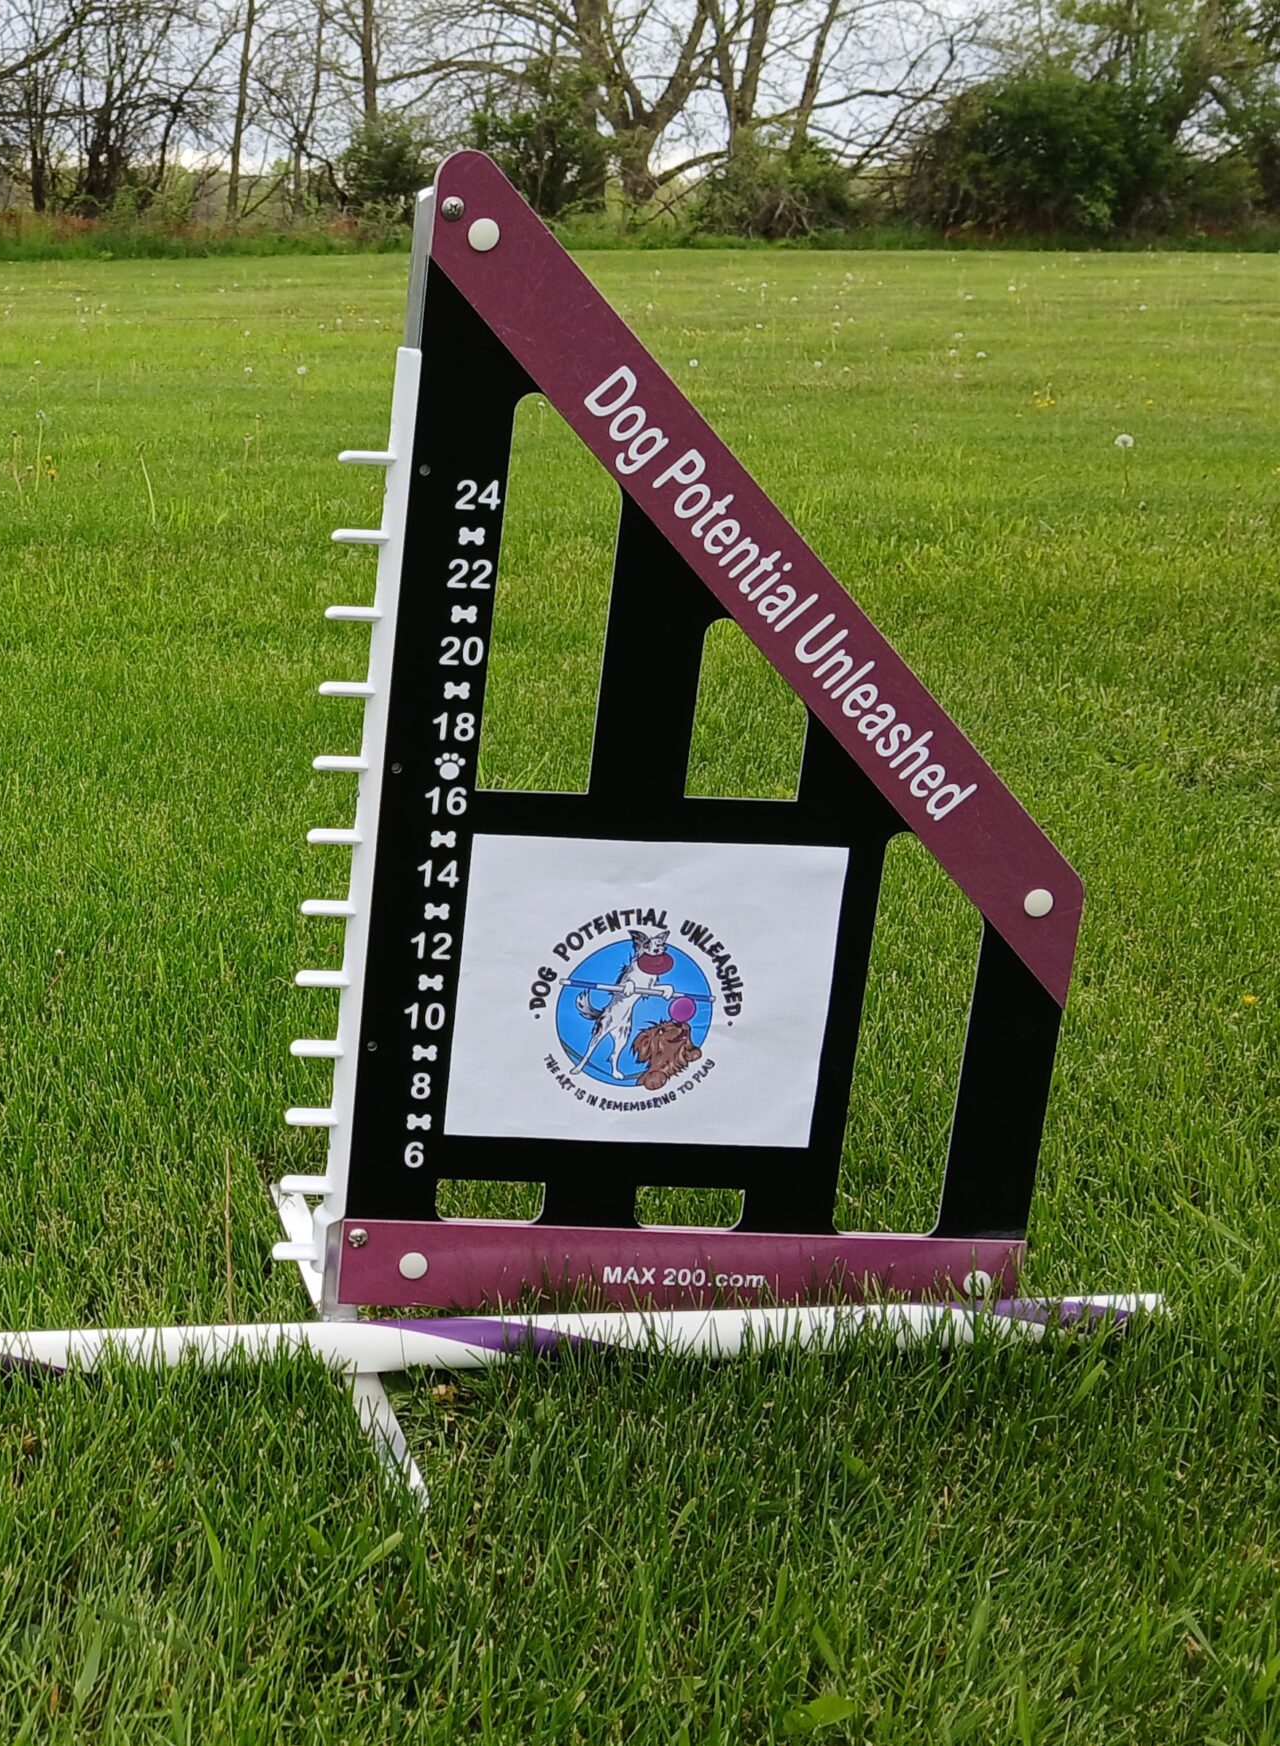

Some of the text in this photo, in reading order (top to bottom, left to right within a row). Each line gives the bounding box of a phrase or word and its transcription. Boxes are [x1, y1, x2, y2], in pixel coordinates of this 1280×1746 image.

[455, 480, 501, 511] 24
[447, 559, 492, 589] 22
[584, 365, 977, 822] Dog Potential Unleashed
[439, 637, 483, 665] 20
[433, 712, 474, 741] 18
[425, 787, 466, 815] 16
[418, 860, 459, 887] 14
[411, 932, 452, 959] 12
[529, 908, 744, 1017] DOG POTENTIAL UNLEASHED
[405, 1003, 445, 1030] 10
[411, 1073, 430, 1099] 8
[543, 1054, 715, 1112] THE ART IS IN REMEMBERING TO PLAY
[405, 1142, 423, 1167] 6
[603, 1266, 766, 1288] MAX 200.com
